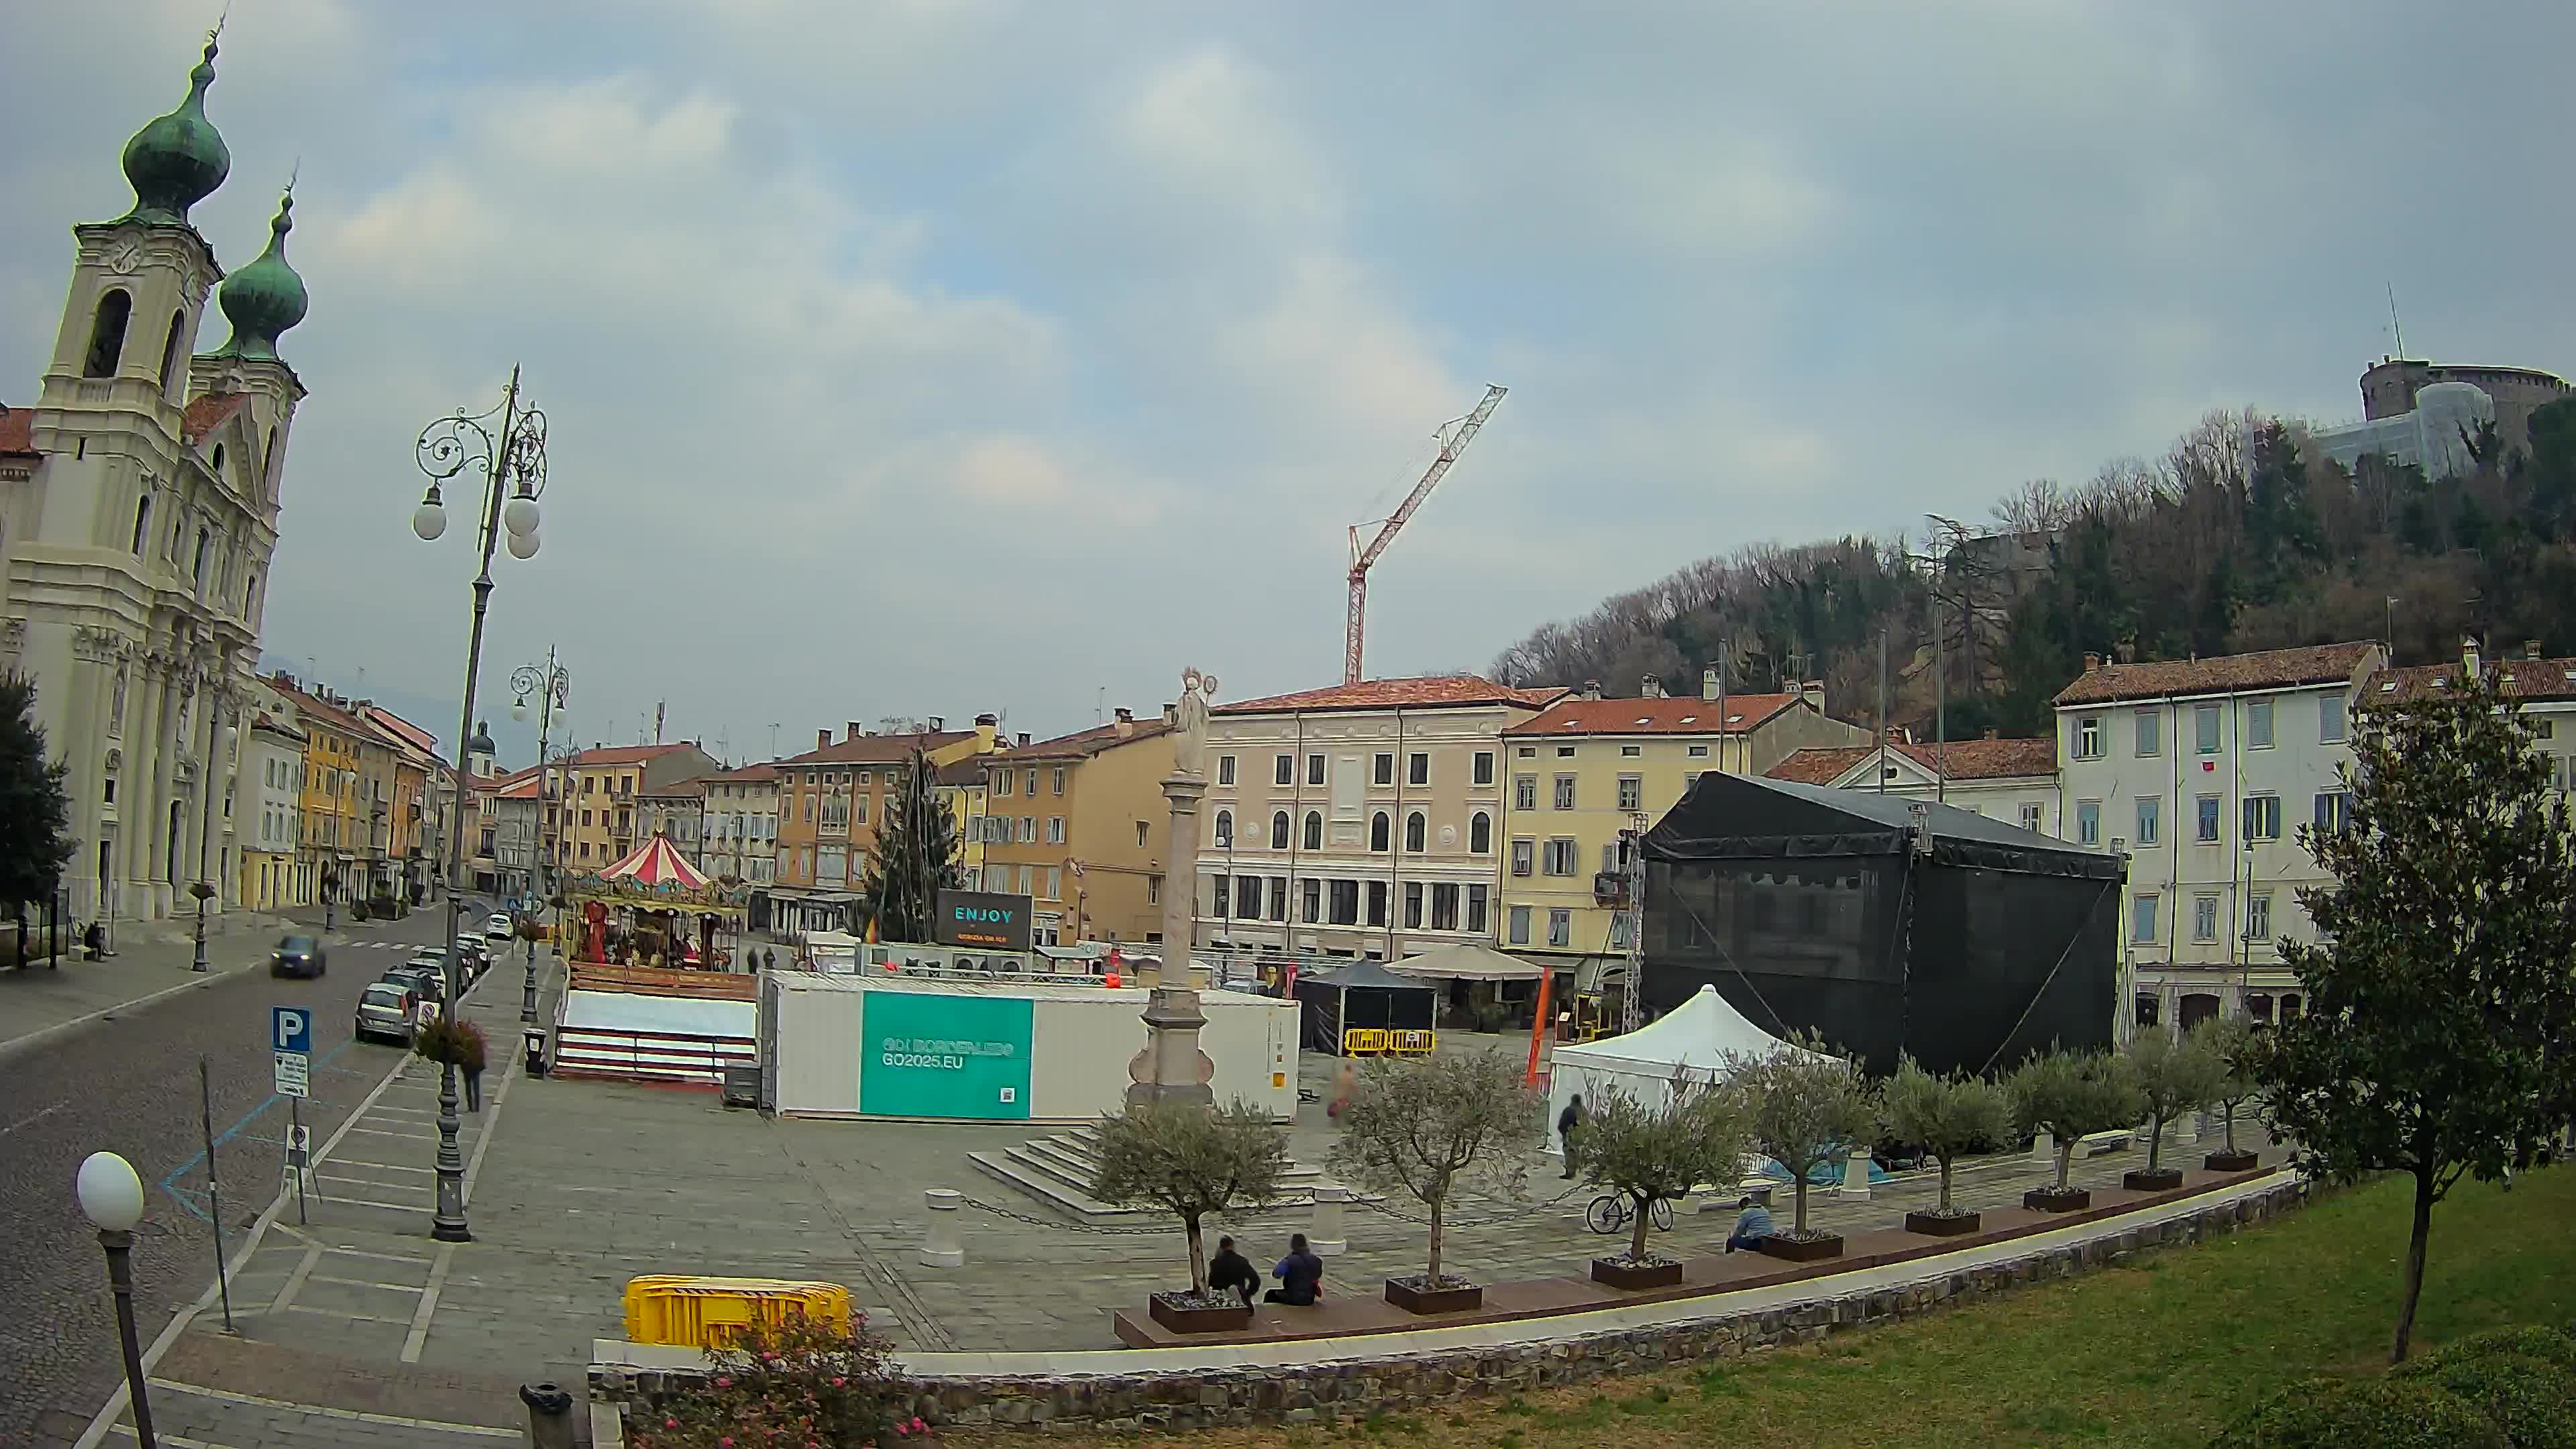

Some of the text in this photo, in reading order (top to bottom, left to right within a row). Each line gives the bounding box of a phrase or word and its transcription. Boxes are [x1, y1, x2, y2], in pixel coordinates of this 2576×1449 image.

[526, 890, 533, 900] P
[955, 906, 1013, 923] ENJOY
[279, 1011, 303, 1047] P
[882, 1053, 963, 1069] GO2025.EU
